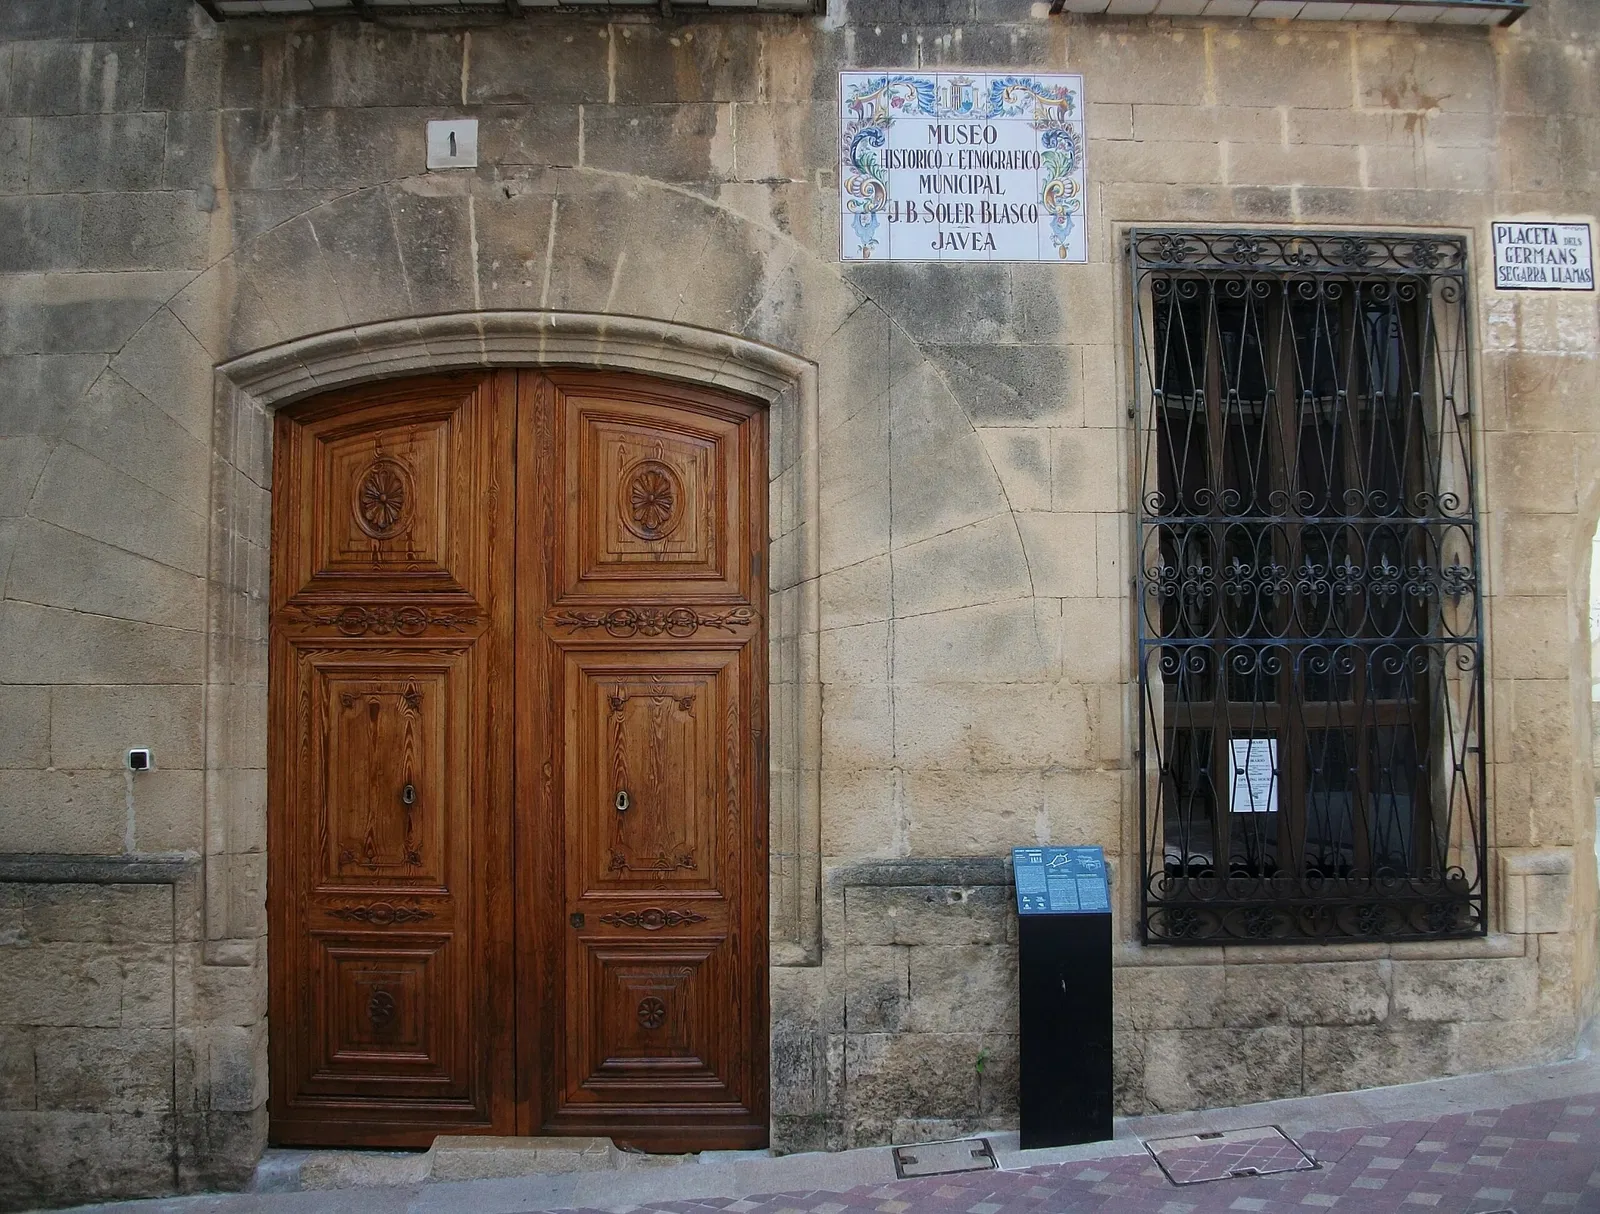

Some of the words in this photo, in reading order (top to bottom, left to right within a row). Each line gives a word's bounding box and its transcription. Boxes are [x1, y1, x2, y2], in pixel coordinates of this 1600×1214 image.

[447, 131, 457, 157] 1
[927, 124, 998, 145] MUSEO
[880, 149, 942, 170] HISTORICO
[958, 149, 1041, 171] ETNOGRAFICO
[919, 174, 1006, 196] MUNICIPAL
[923, 200, 975, 224] SOLER
[980, 200, 1039, 225] BLASCO
[931, 232, 997, 252] JAVEA
[1497, 226, 1558, 245] PLACETA
[1563, 237, 1582, 246] DELS
[1505, 246, 1577, 265] GERMANS
[1498, 265, 1548, 283] SEGARRA
[1551, 267, 1592, 283] LLAMAS
